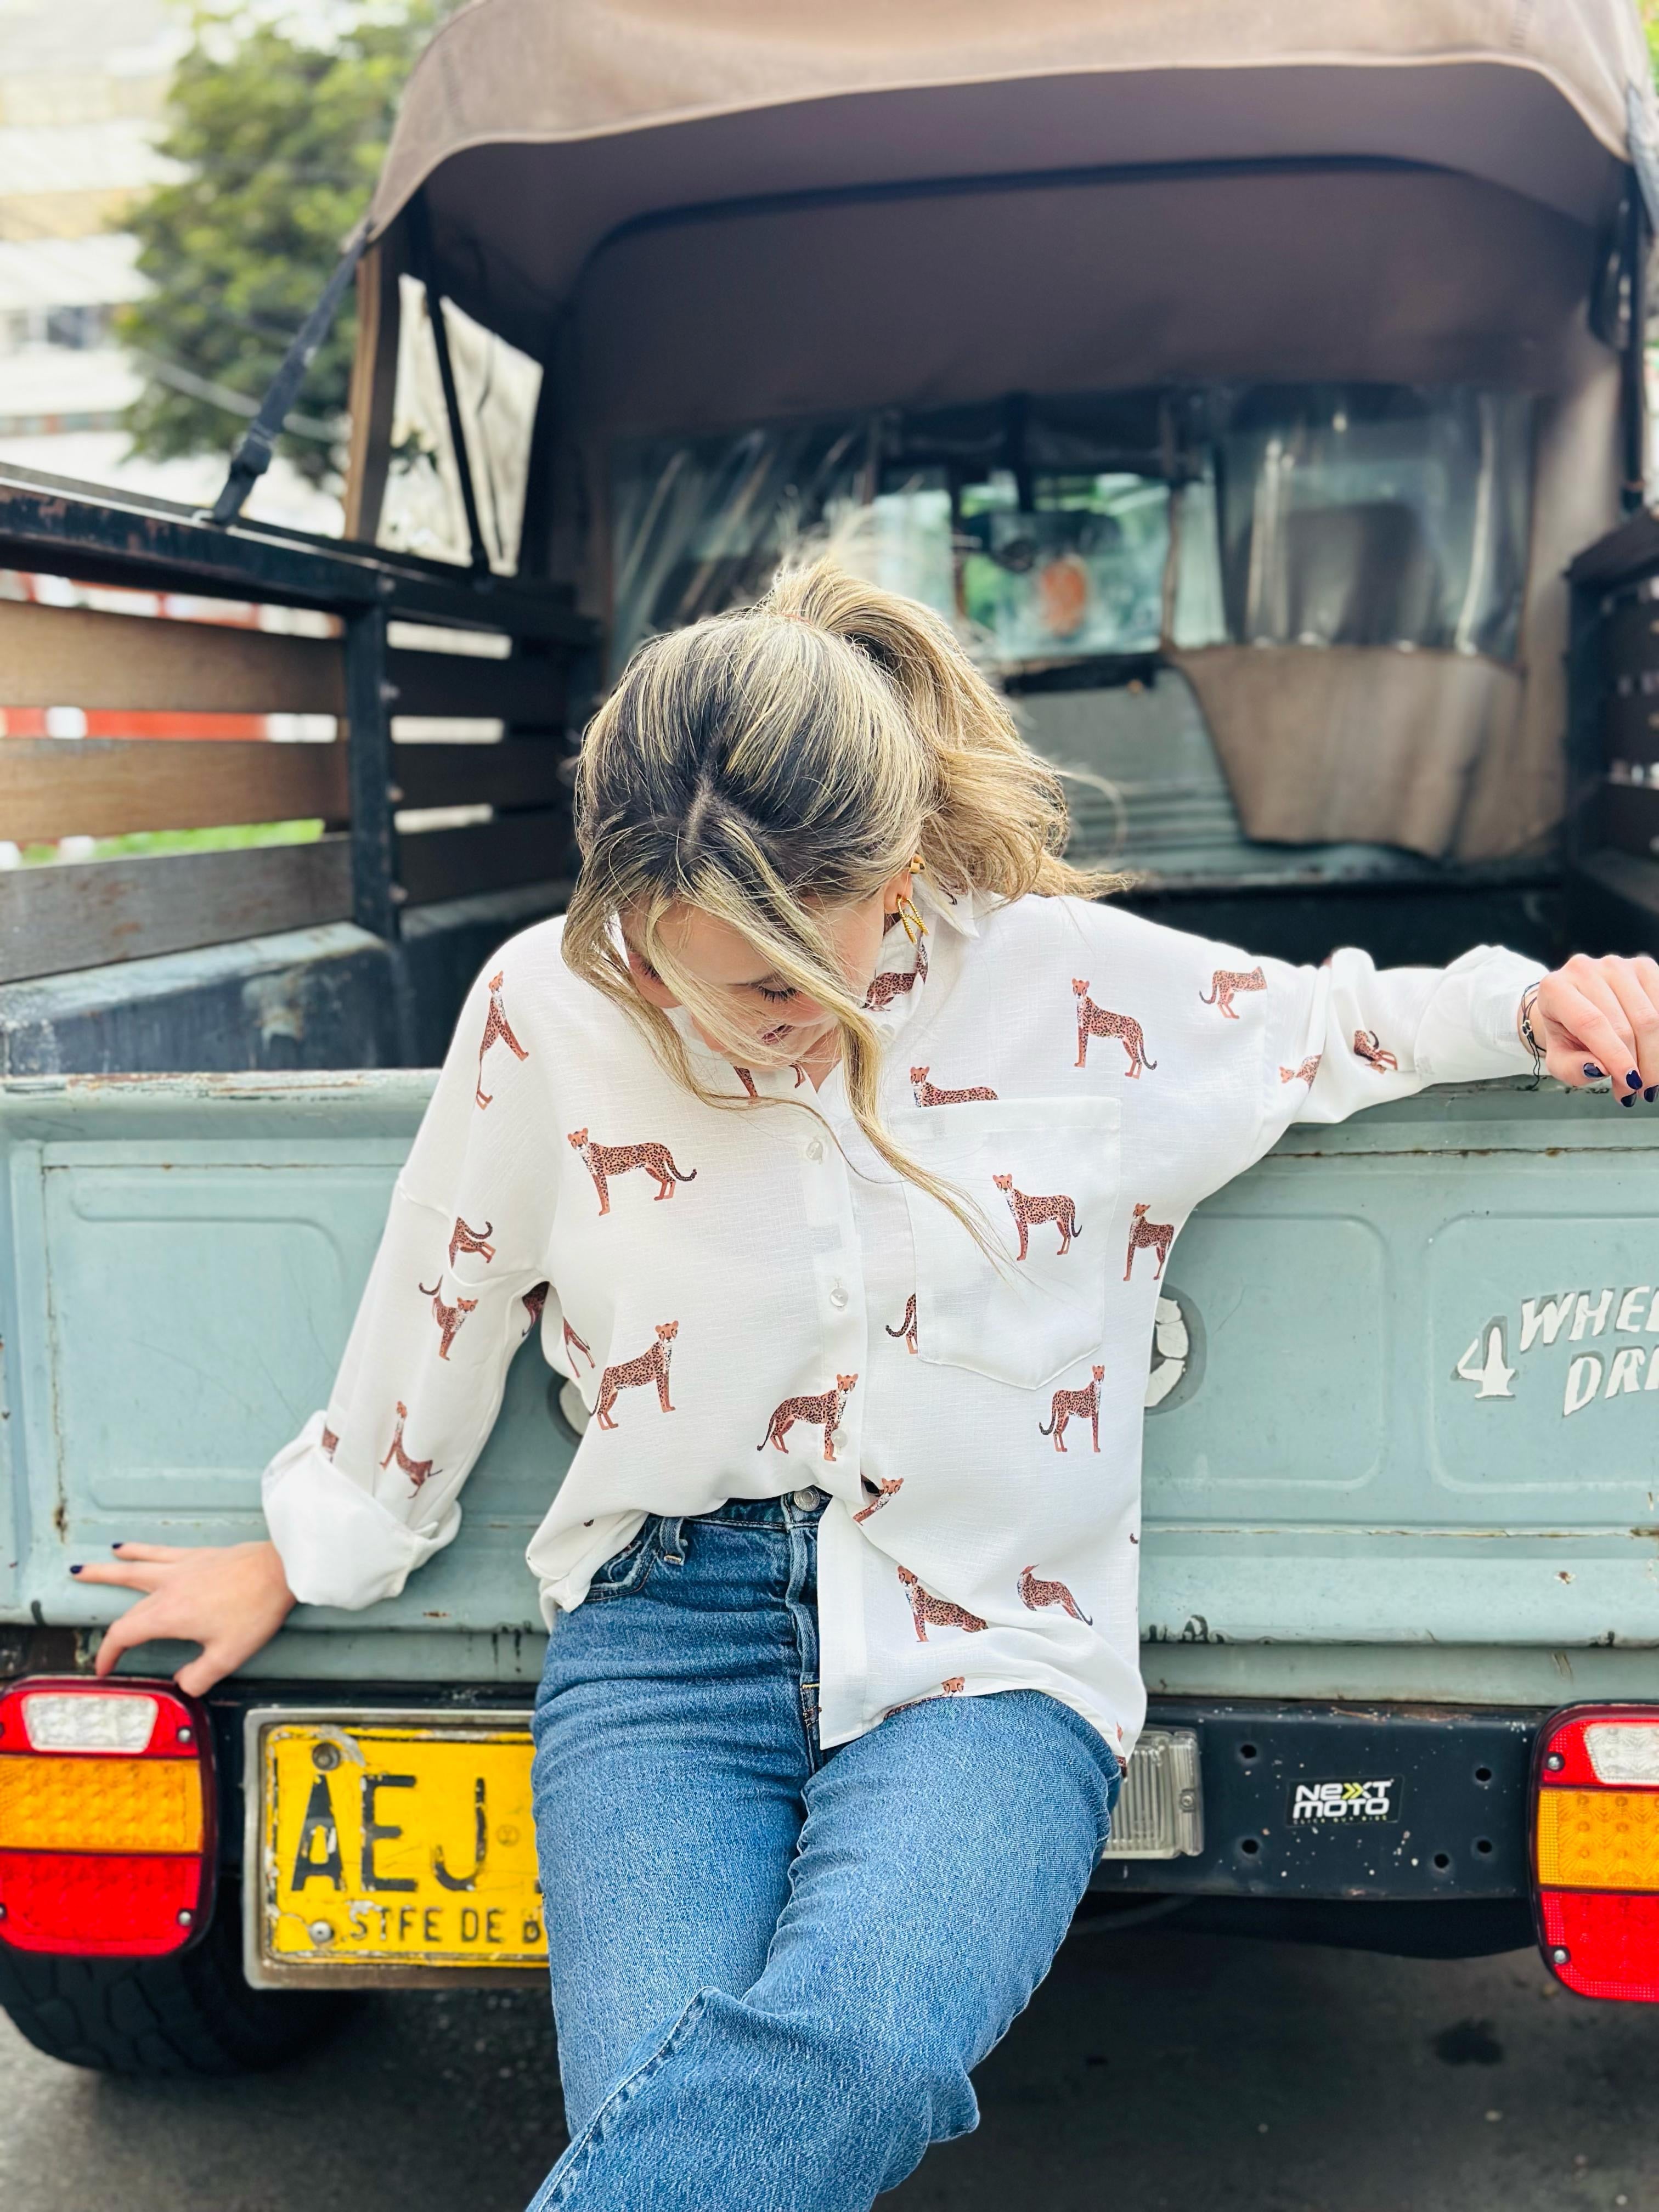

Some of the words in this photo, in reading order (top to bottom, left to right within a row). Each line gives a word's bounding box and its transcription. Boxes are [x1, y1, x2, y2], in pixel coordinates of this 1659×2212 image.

[1454, 1318, 1516, 1399] 4
[291, 1774, 487, 1892] AEJ
[462, 1908, 505, 1943] DE
